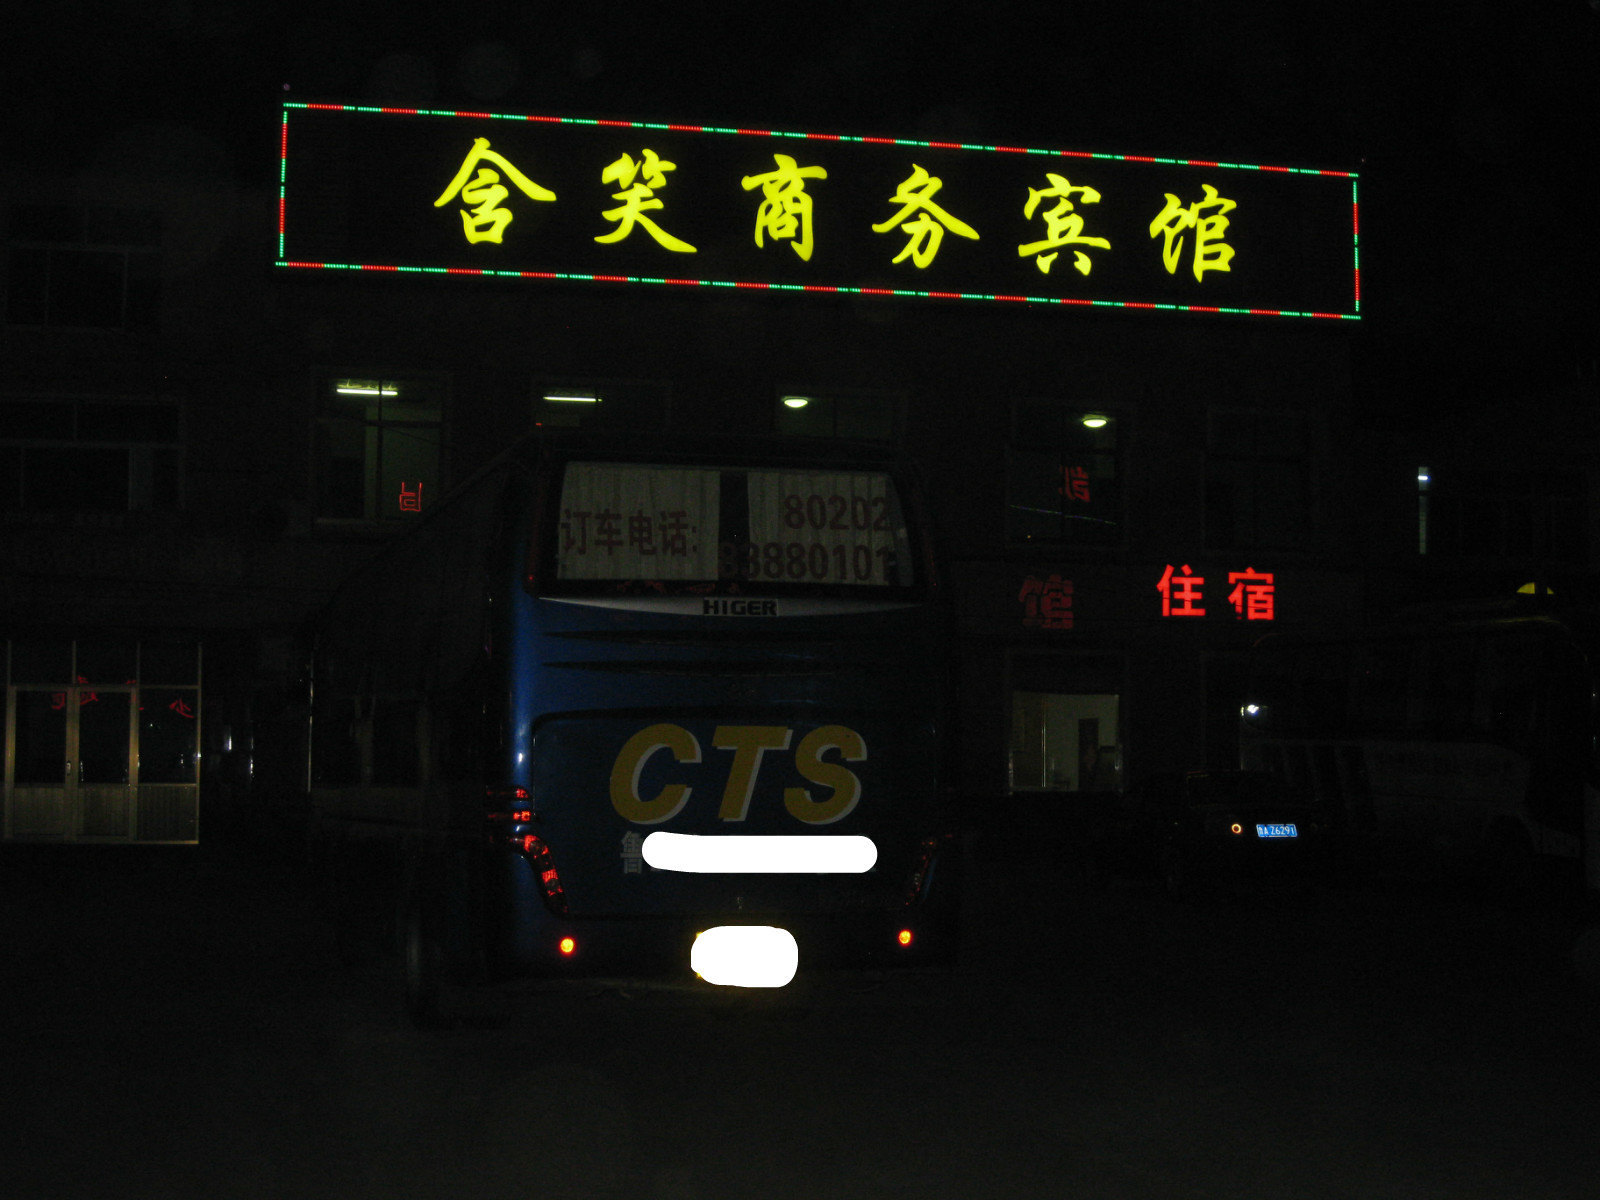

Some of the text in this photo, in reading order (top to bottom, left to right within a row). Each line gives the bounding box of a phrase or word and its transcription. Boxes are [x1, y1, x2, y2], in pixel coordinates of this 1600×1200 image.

[434, 137, 1239, 282] 含笑商务宾馆
[703, 600, 777, 616] HIGER
[1156, 563, 1276, 621] 住宿
[609, 723, 867, 824] CTS
